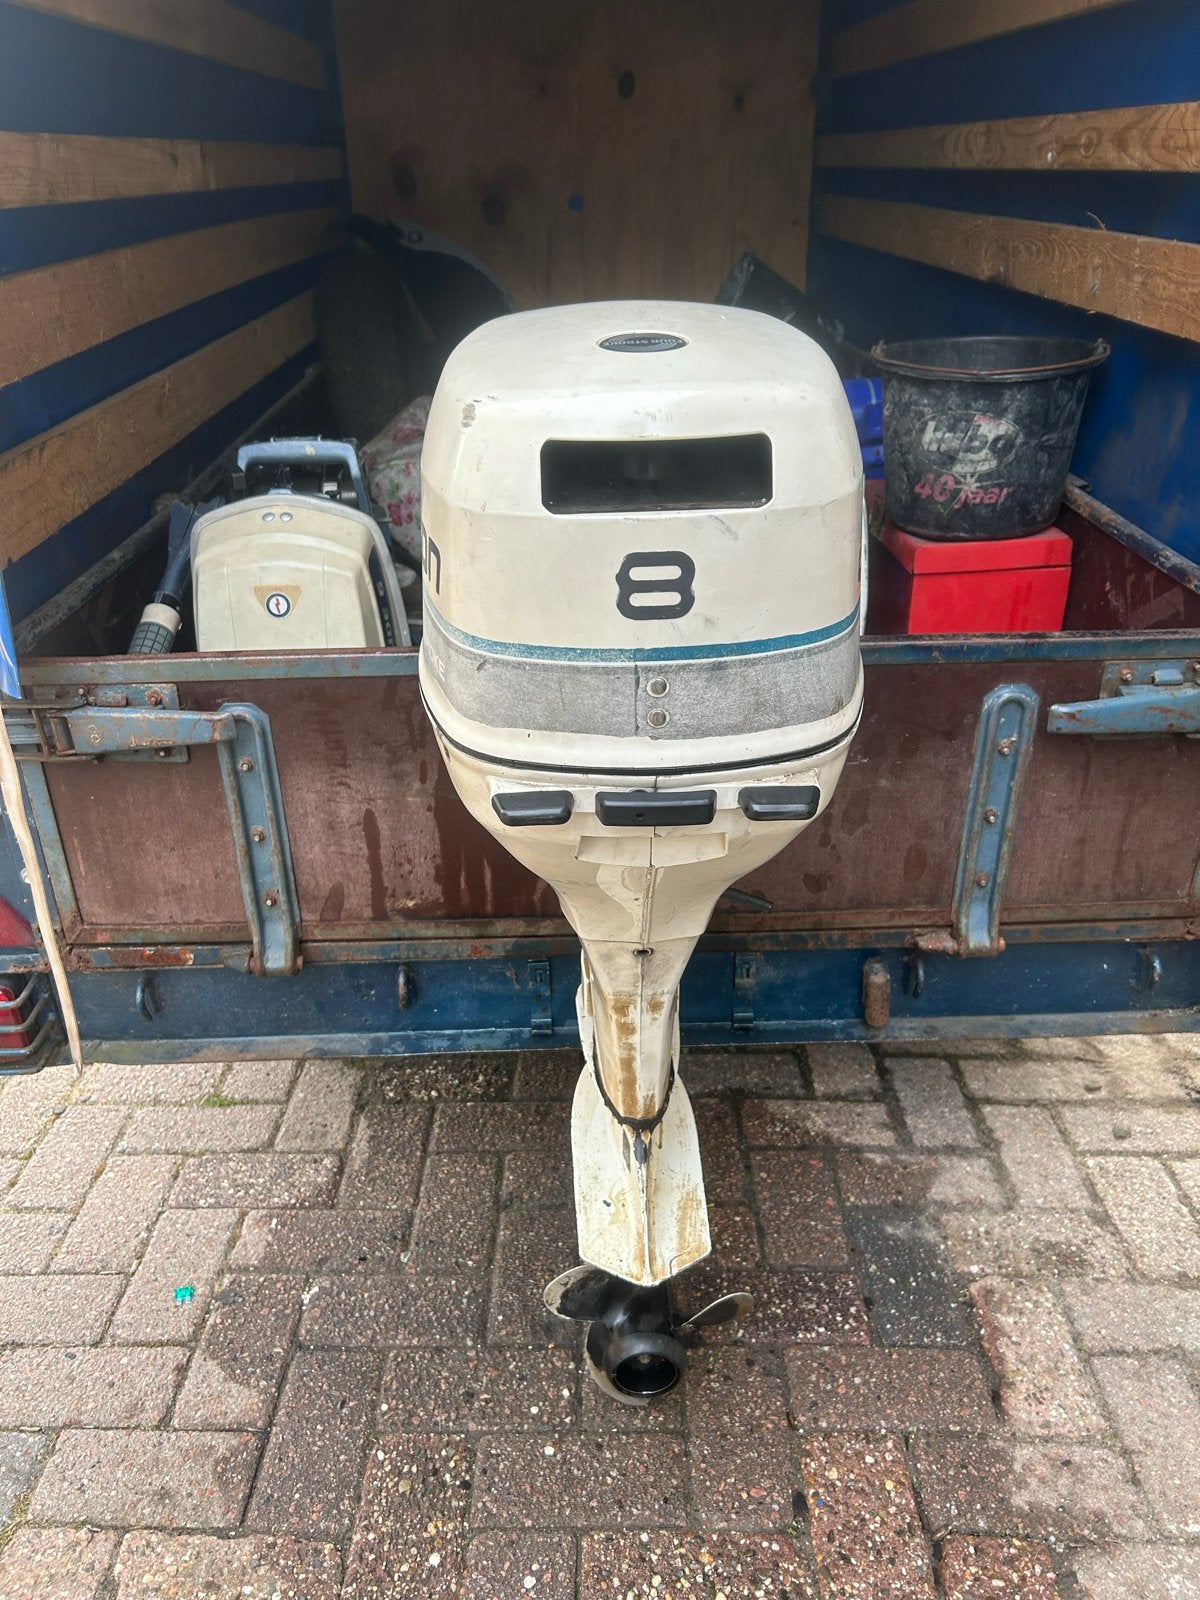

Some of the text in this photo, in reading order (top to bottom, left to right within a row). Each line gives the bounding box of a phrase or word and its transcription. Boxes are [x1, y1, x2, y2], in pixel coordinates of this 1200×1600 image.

[914, 474, 1014, 510] 40 jaar
[615, 551, 696, 621] 8
